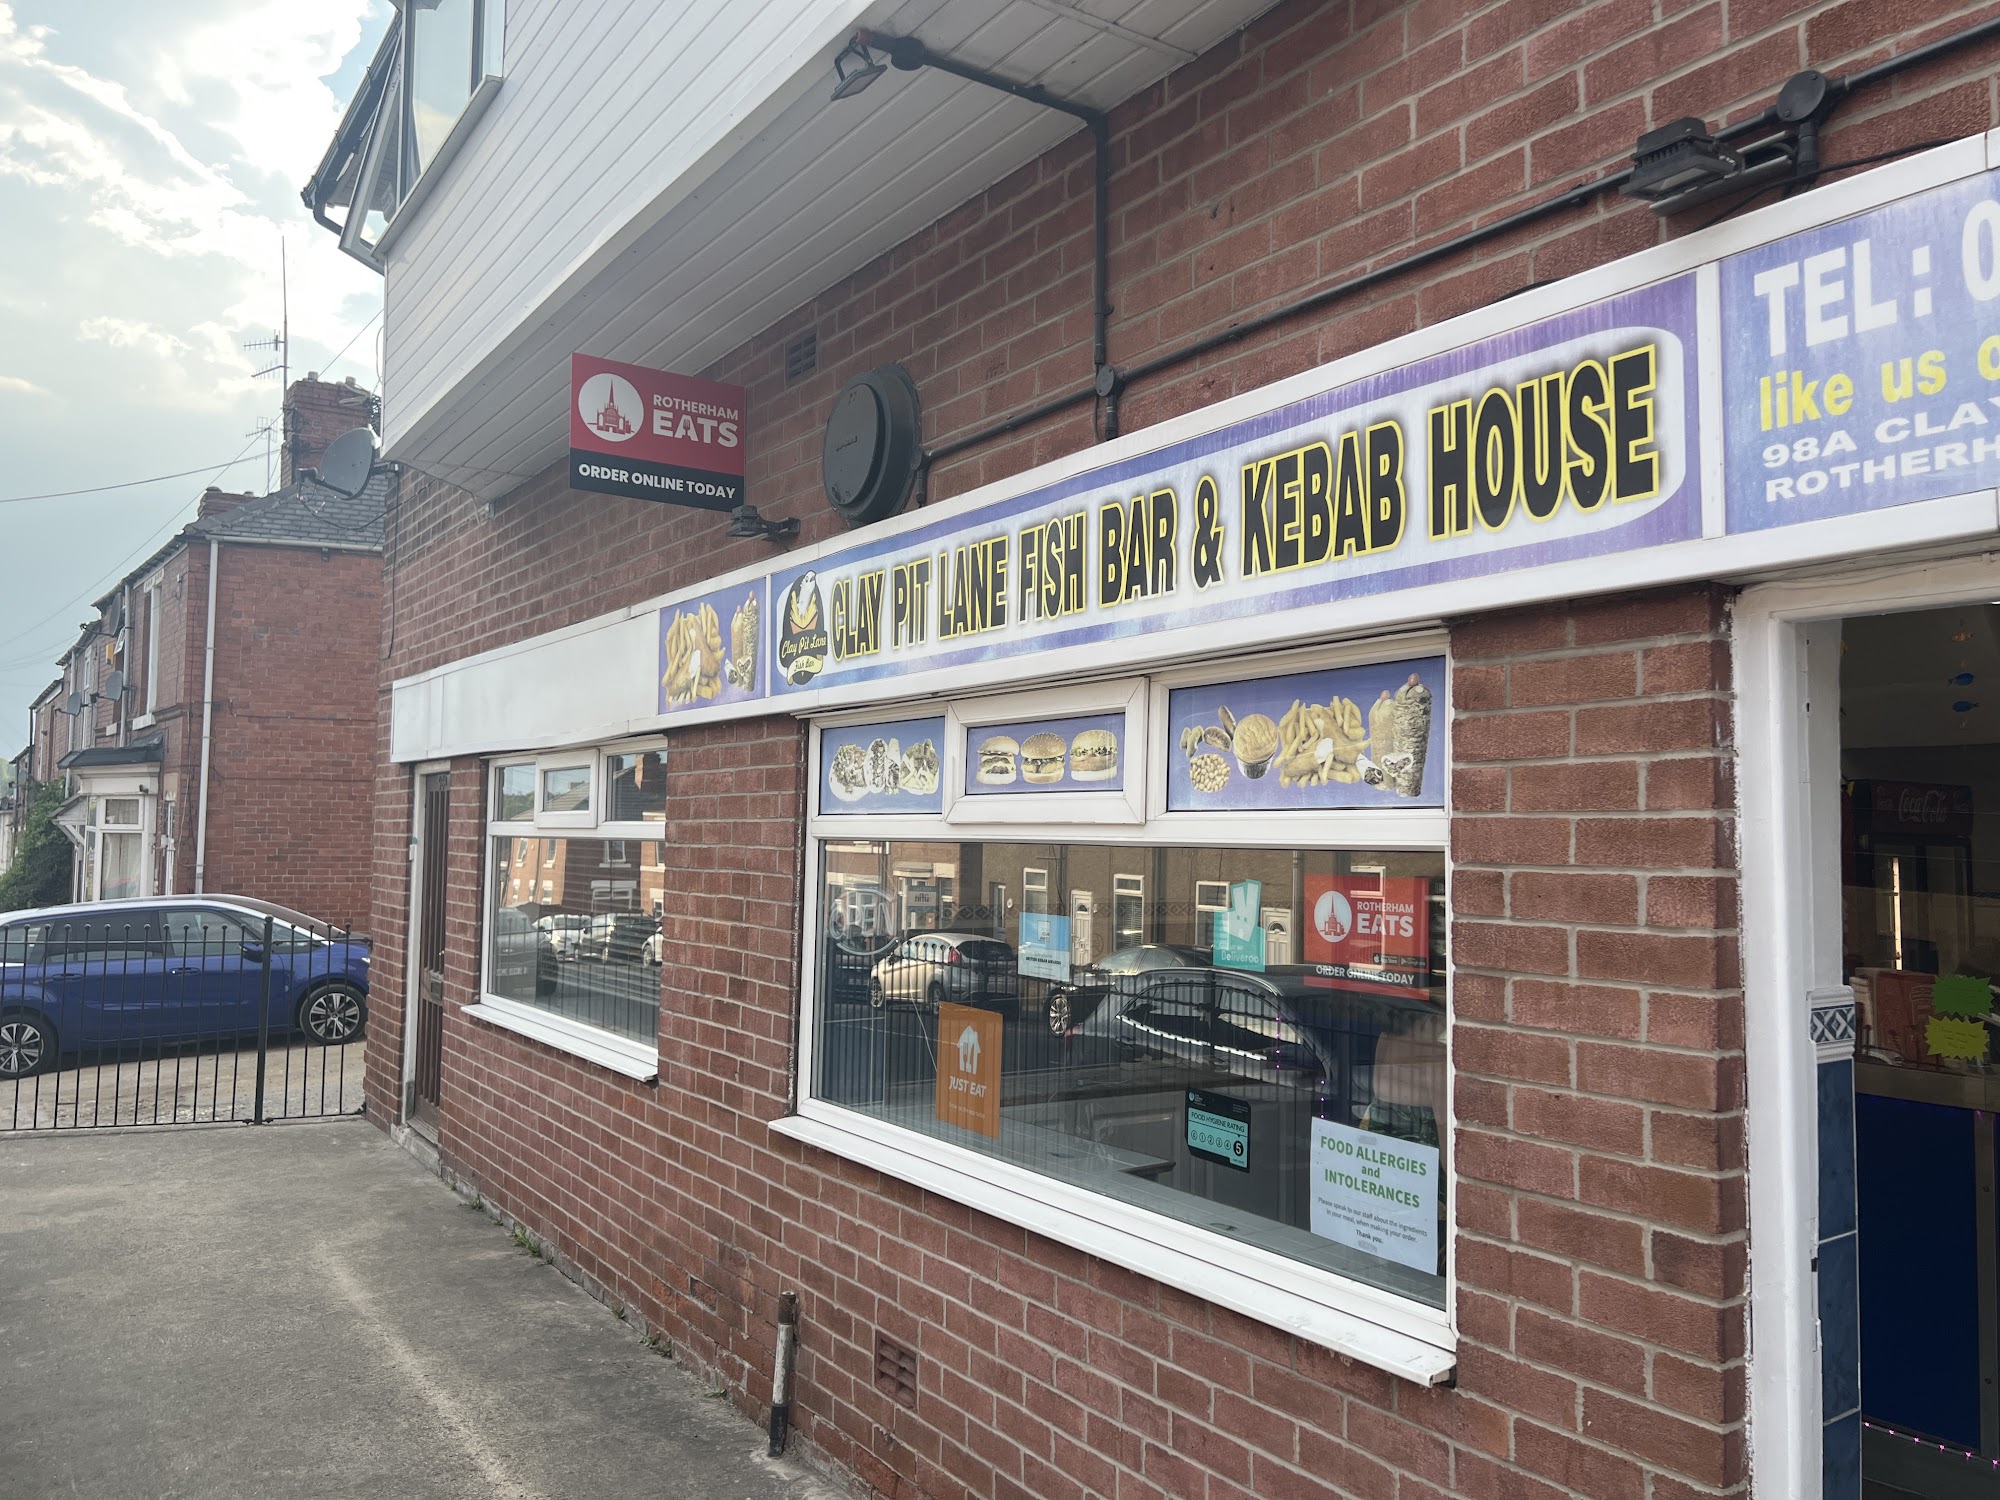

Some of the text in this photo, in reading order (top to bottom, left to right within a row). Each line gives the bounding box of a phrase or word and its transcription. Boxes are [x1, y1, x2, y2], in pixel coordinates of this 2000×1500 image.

[1759, 369, 1854, 431] like
[1881, 350, 1947, 403] us
[653, 394, 739, 421] ROTHERHAM
[652, 409, 739, 448] EATS
[1763, 396, 2000, 468] 98A CLA
[578, 463, 736, 499] ORDER ONLINE TODAY
[831, 343, 1659, 663] CLAY PIT LANE FISH BAR & KEBAB HOUSE
[781, 633, 827, 659] Clay Pit Lane
[830, 902, 898, 940] OPEN
[1357, 901, 1414, 914] ROTHERHAM
[1356, 913, 1414, 938] EATS
[1221, 949, 1259, 964] Deliveroo
[1315, 965, 1345, 978] ORDER
[1380, 971, 1415, 985] TODAY
[949, 1075, 987, 1098] JUST EAT
[1191, 1111, 1245, 1133] FOOD HYGIENE RATING
[1320, 1135, 1427, 1177] FOOD ALLERGIES
[1361, 1165, 1380, 1179] and
[1324, 1169, 1420, 1209] INTOLERANCES
[1318, 1196, 1333, 1207] Please
[1333, 1202, 1347, 1212] speak
[1362, 1210, 1373, 1220] staff
[1373, 1214, 1389, 1225] about
[1389, 1219, 1398, 1228] the
[1398, 1221, 1428, 1237] ingredients
[1332, 1210, 1342, 1219] your
[1356, 1218, 1370, 1228] when
[1370, 1220, 1389, 1235] making
[1390, 1229, 1402, 1238] your
[1401, 1231, 1418, 1243] order.
[1356, 1229, 1384, 1244] Thank you.
